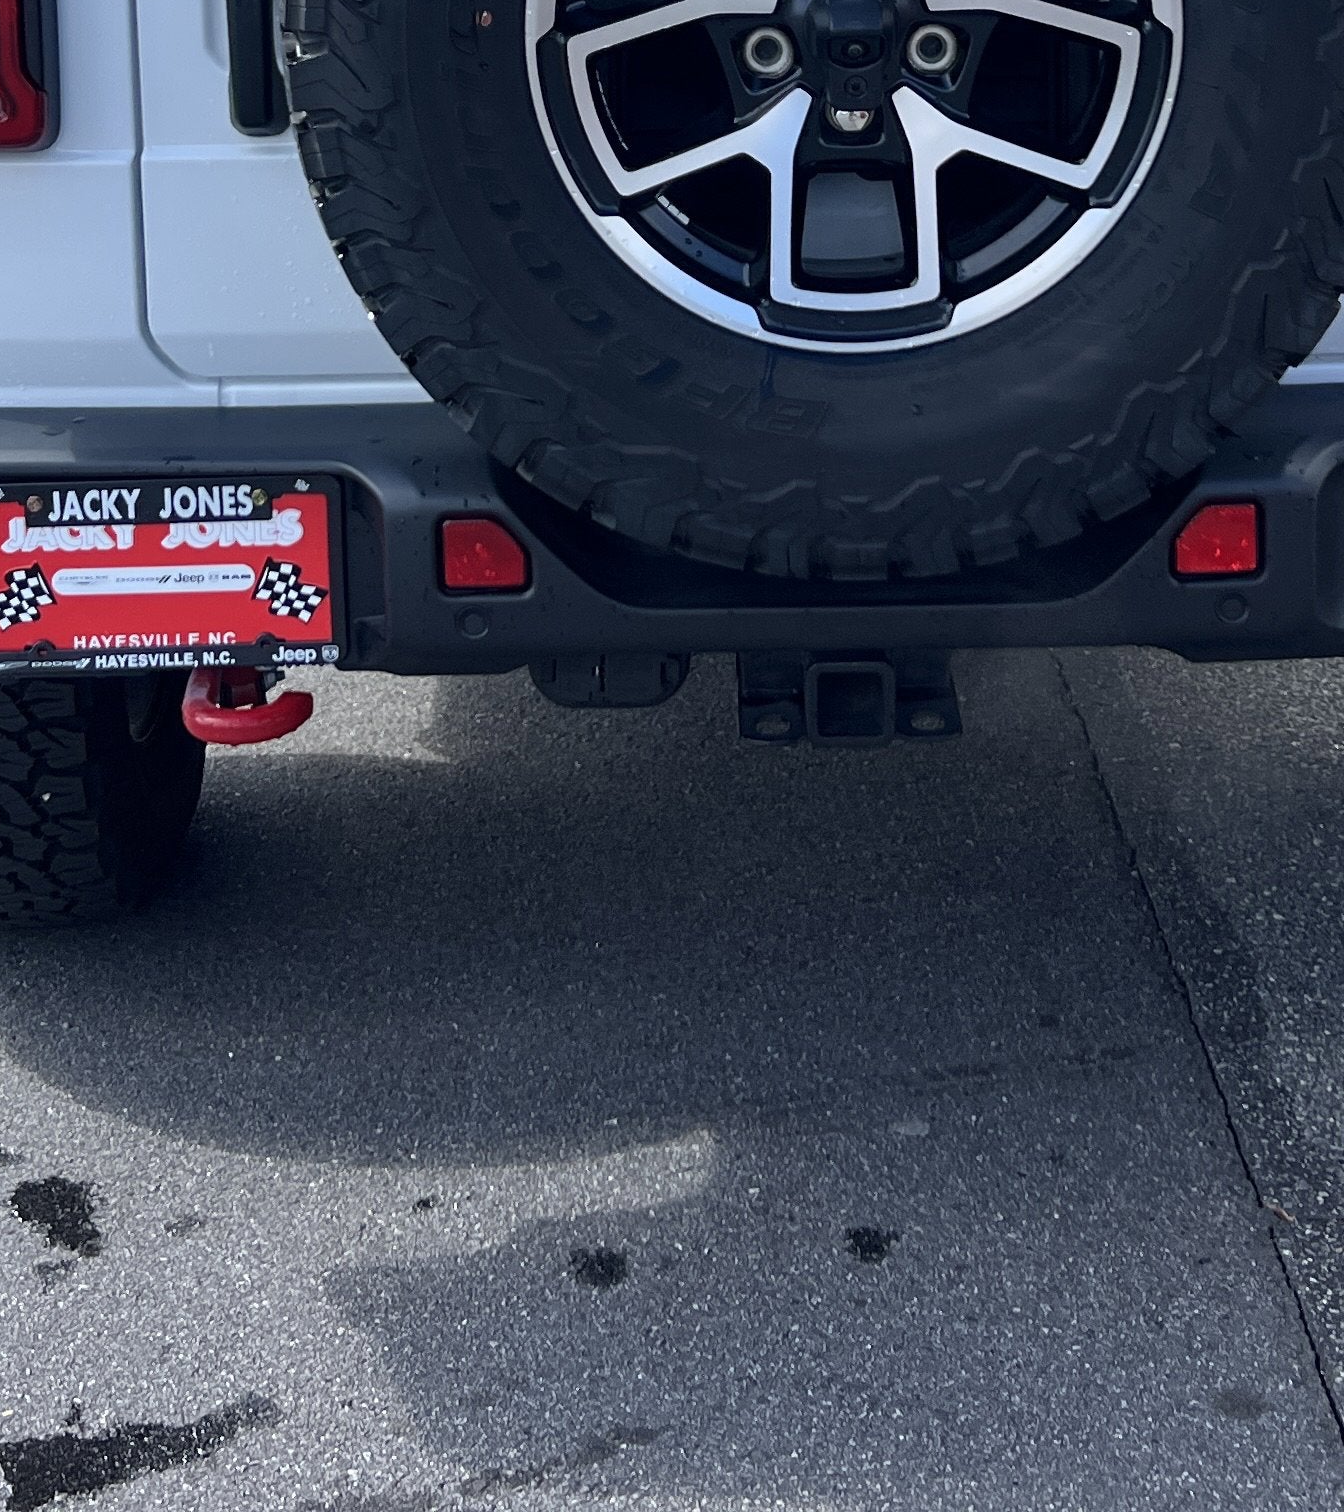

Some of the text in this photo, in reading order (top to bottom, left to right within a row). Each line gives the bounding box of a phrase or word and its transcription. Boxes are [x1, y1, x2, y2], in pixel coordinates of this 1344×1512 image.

[48, 484, 254, 522] JACKY JONES
[1, 508, 304, 553] JACKY JONES
[174, 573, 205, 584] Jeep
[208, 631, 236, 645] NC
[95, 651, 199, 668] HAYESVILLE,
[203, 651, 236, 665] N.C.
[272, 646, 317, 663] Jeep
